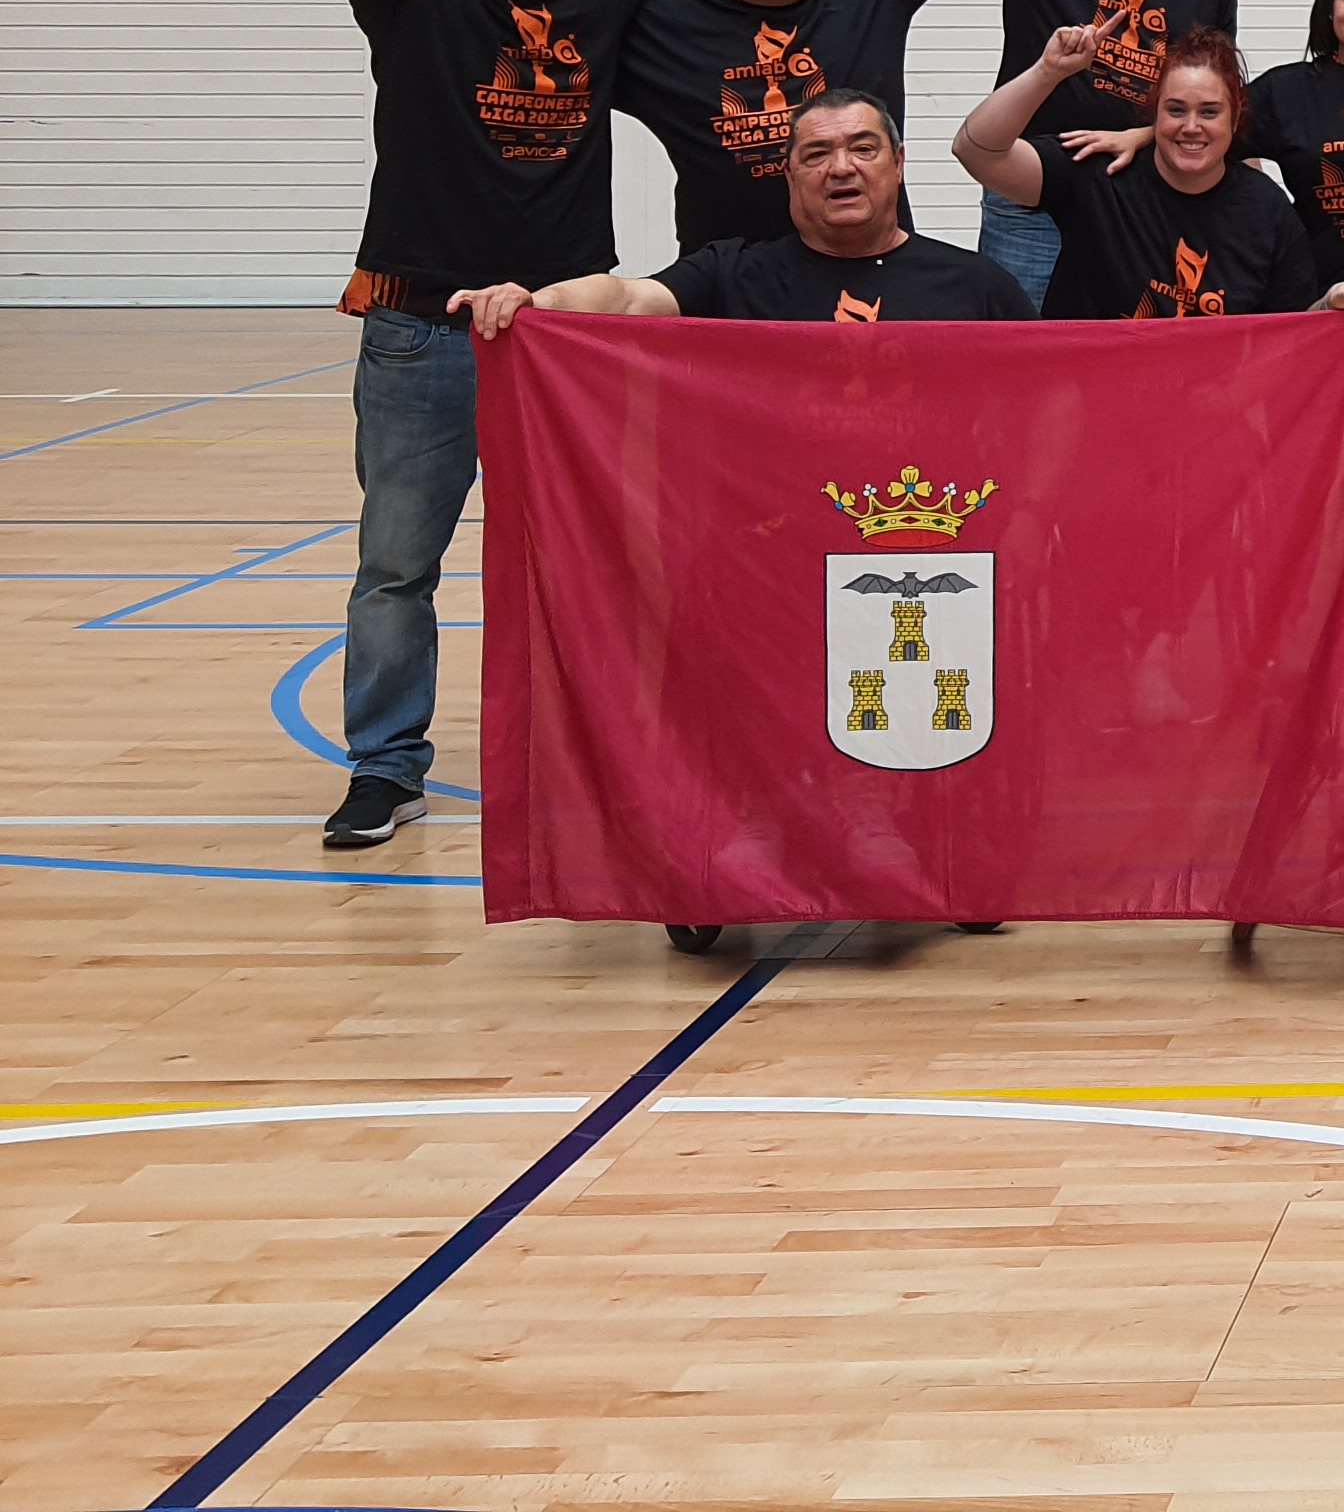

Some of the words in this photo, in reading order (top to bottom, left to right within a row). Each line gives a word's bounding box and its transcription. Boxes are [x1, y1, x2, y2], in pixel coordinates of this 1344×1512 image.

[724, 59, 786, 80] amiab
[476, 91, 574, 110] CAMPEONES
[480, 106, 526, 123] LIGA
[721, 130, 764, 146] LIGA
[1150, 279, 1197, 305] amiab
